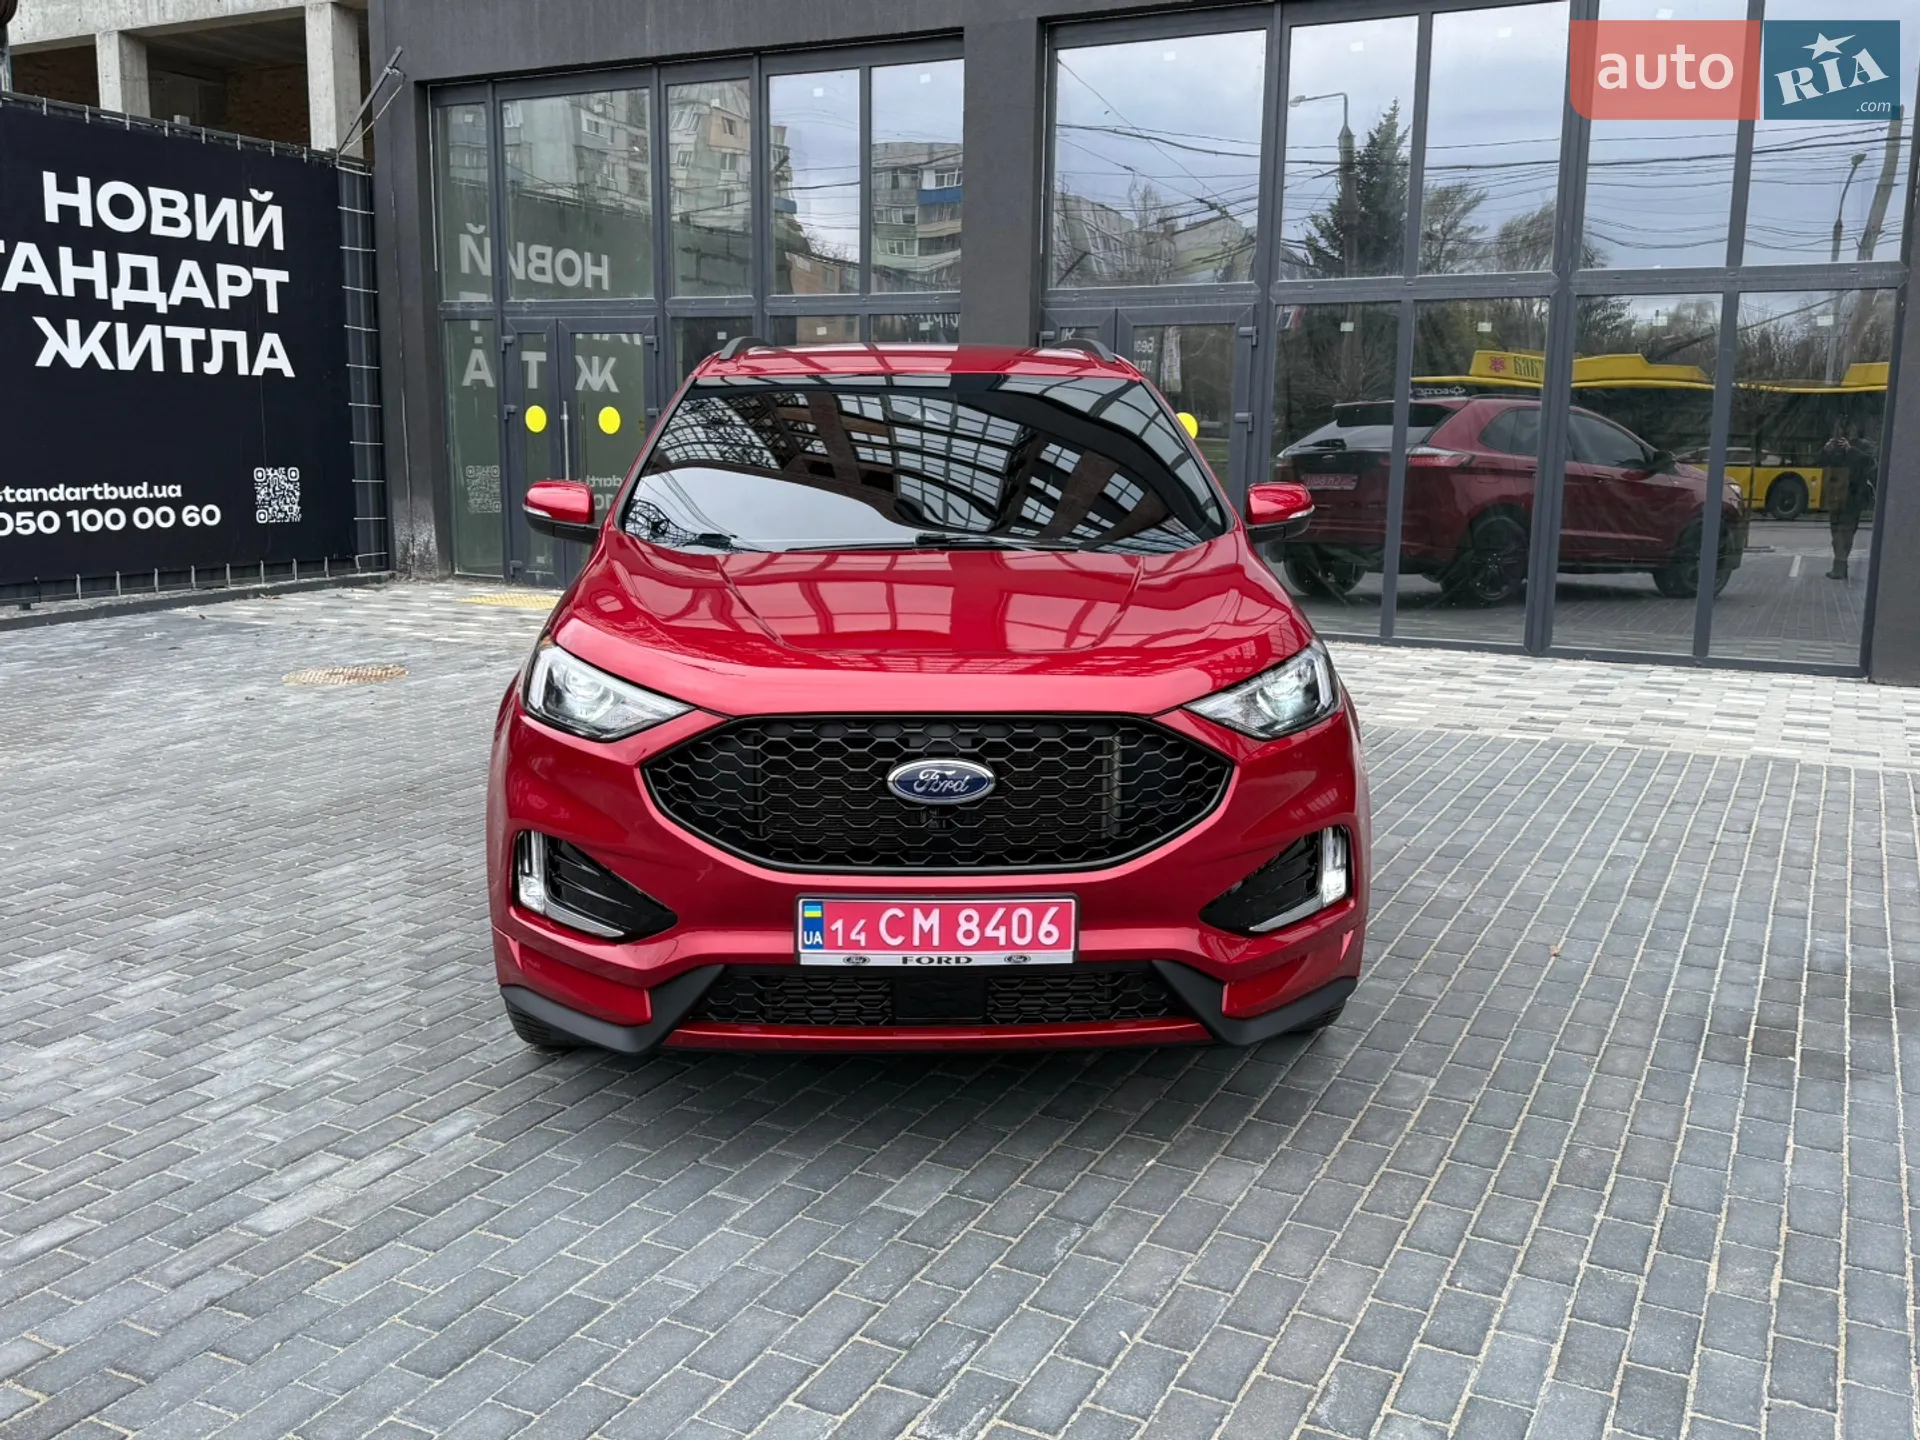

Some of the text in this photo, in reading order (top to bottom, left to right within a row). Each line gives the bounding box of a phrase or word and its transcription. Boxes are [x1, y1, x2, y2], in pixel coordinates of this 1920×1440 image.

[42, 170, 285, 251] НОВИЙ
[32, 315, 296, 378] ЖИТЛА
[66, 508, 127, 533] 100
[132, 506, 176, 530] 00
[181, 504, 221, 527] 60
[913, 769, 970, 793] Ford
[803, 931, 823, 945] UA
[829, 919, 867, 947] 14
[956, 907, 1060, 946] 8406
[901, 956, 973, 965] FORD
